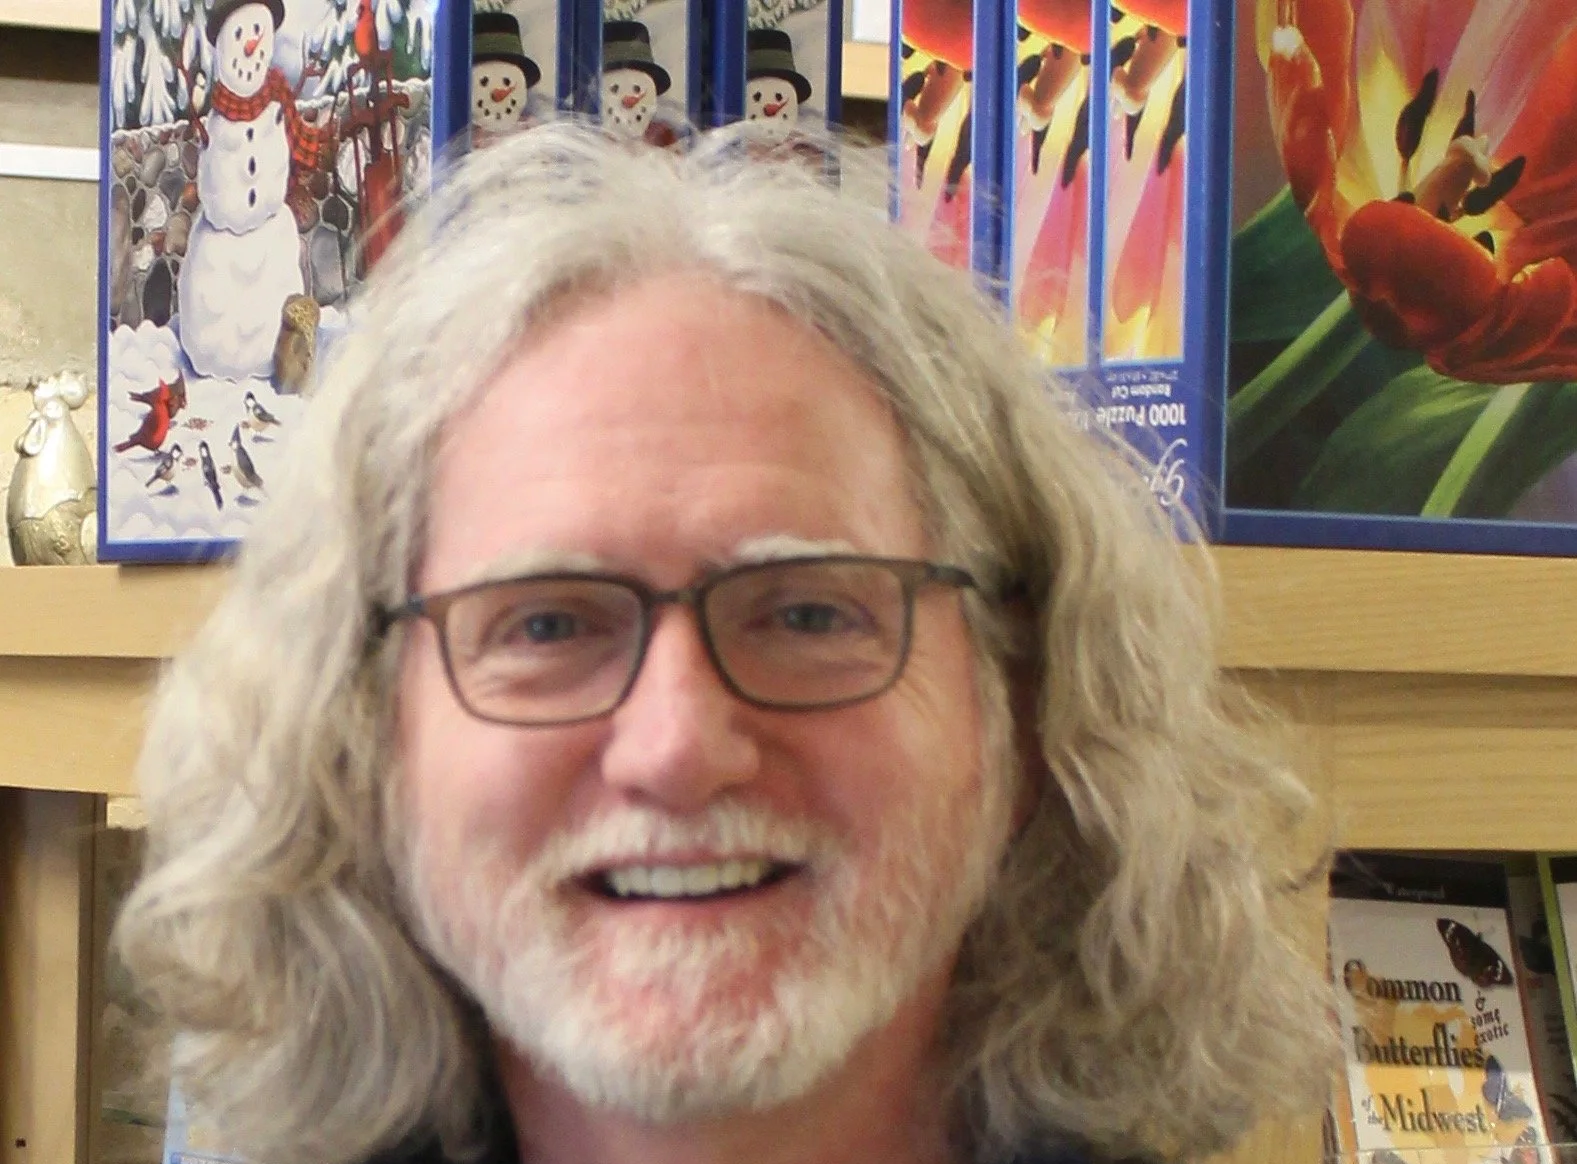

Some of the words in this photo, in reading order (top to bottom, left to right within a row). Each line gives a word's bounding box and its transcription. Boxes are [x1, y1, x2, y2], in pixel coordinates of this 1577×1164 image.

[1130, 383, 1172, 398] Random
[1096, 404, 1145, 428] Puzzle
[1149, 403, 1187, 427] 1000
[1343, 958, 1463, 1003] Common
[1470, 1008, 1500, 1031] some
[1352, 1021, 1487, 1069] Butterflies
[1379, 1087, 1490, 1133] Midwest
